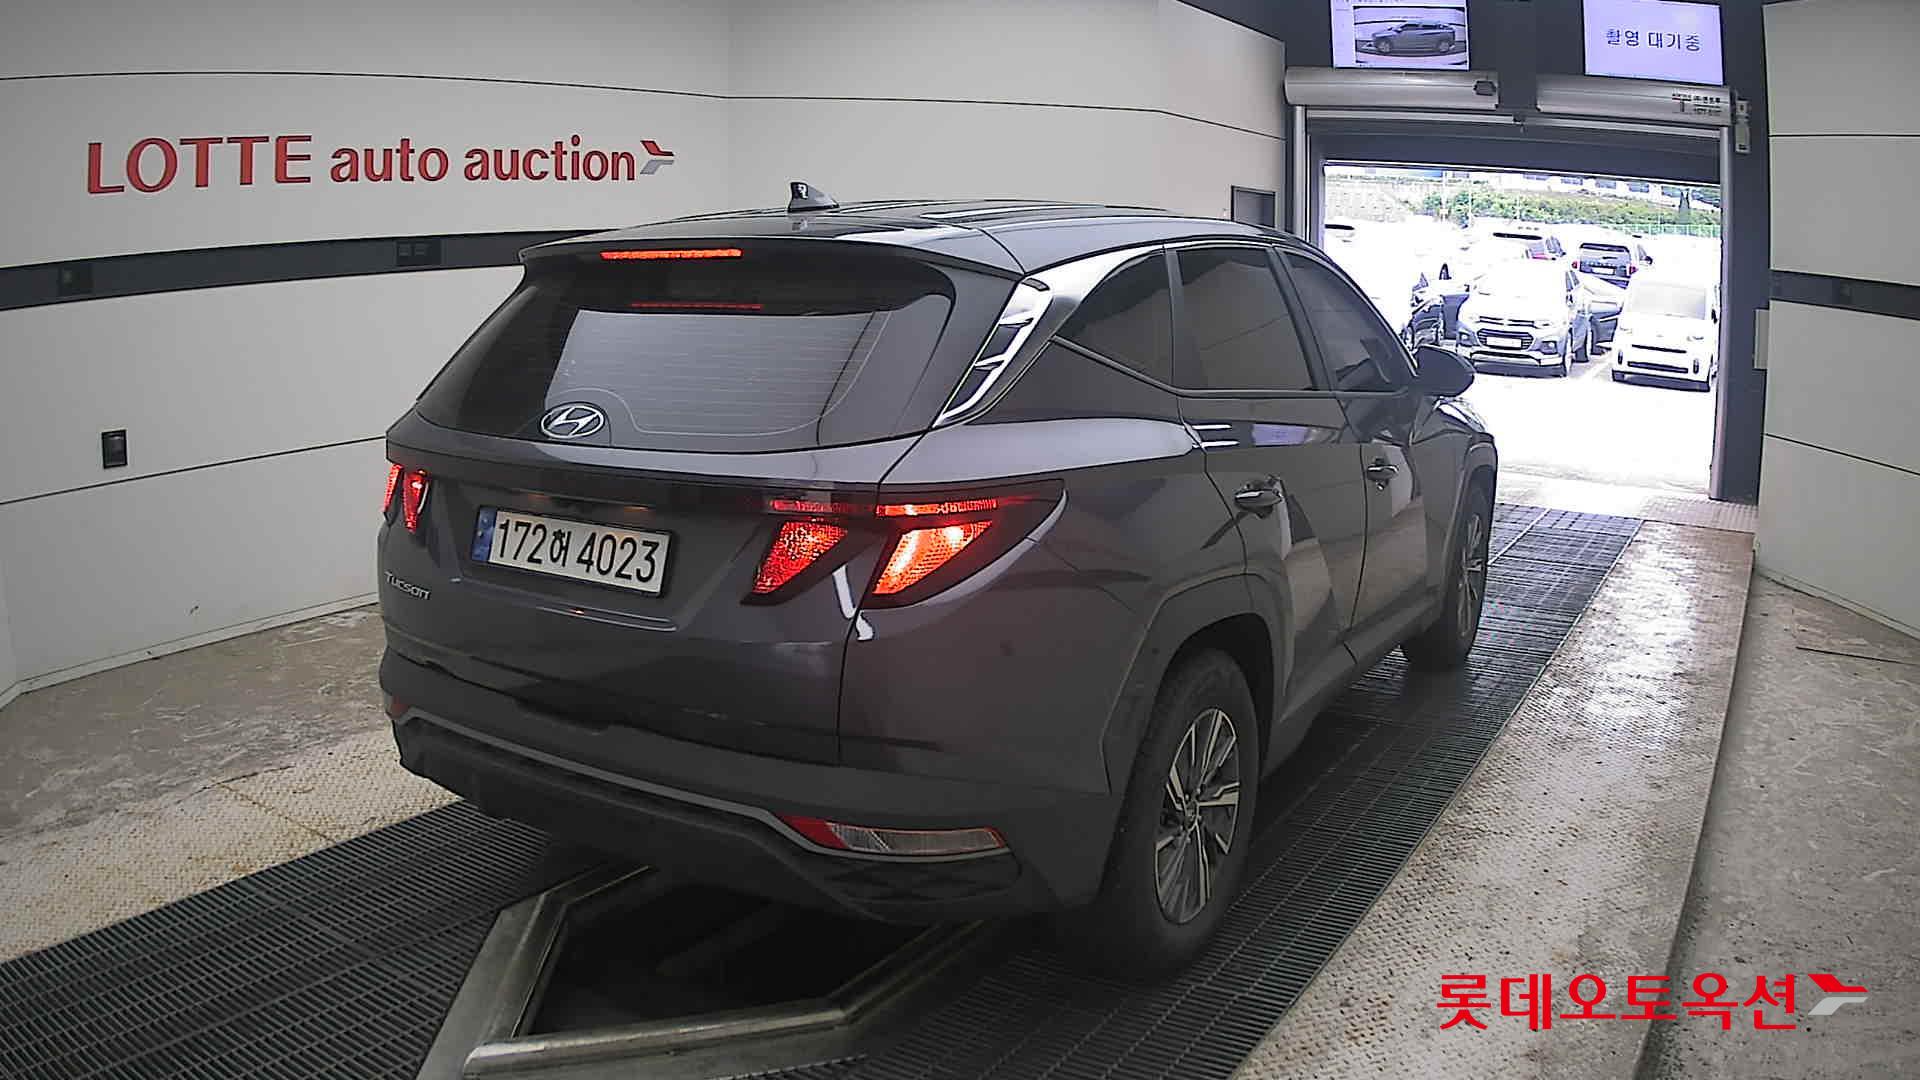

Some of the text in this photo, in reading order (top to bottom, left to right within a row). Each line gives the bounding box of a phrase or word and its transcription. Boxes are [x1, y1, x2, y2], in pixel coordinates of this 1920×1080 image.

[1648, 32, 1701, 52] 대기중
[87, 134, 635, 195] LOTTE auto auction
[499, 518, 660, 583] 172허 4023
